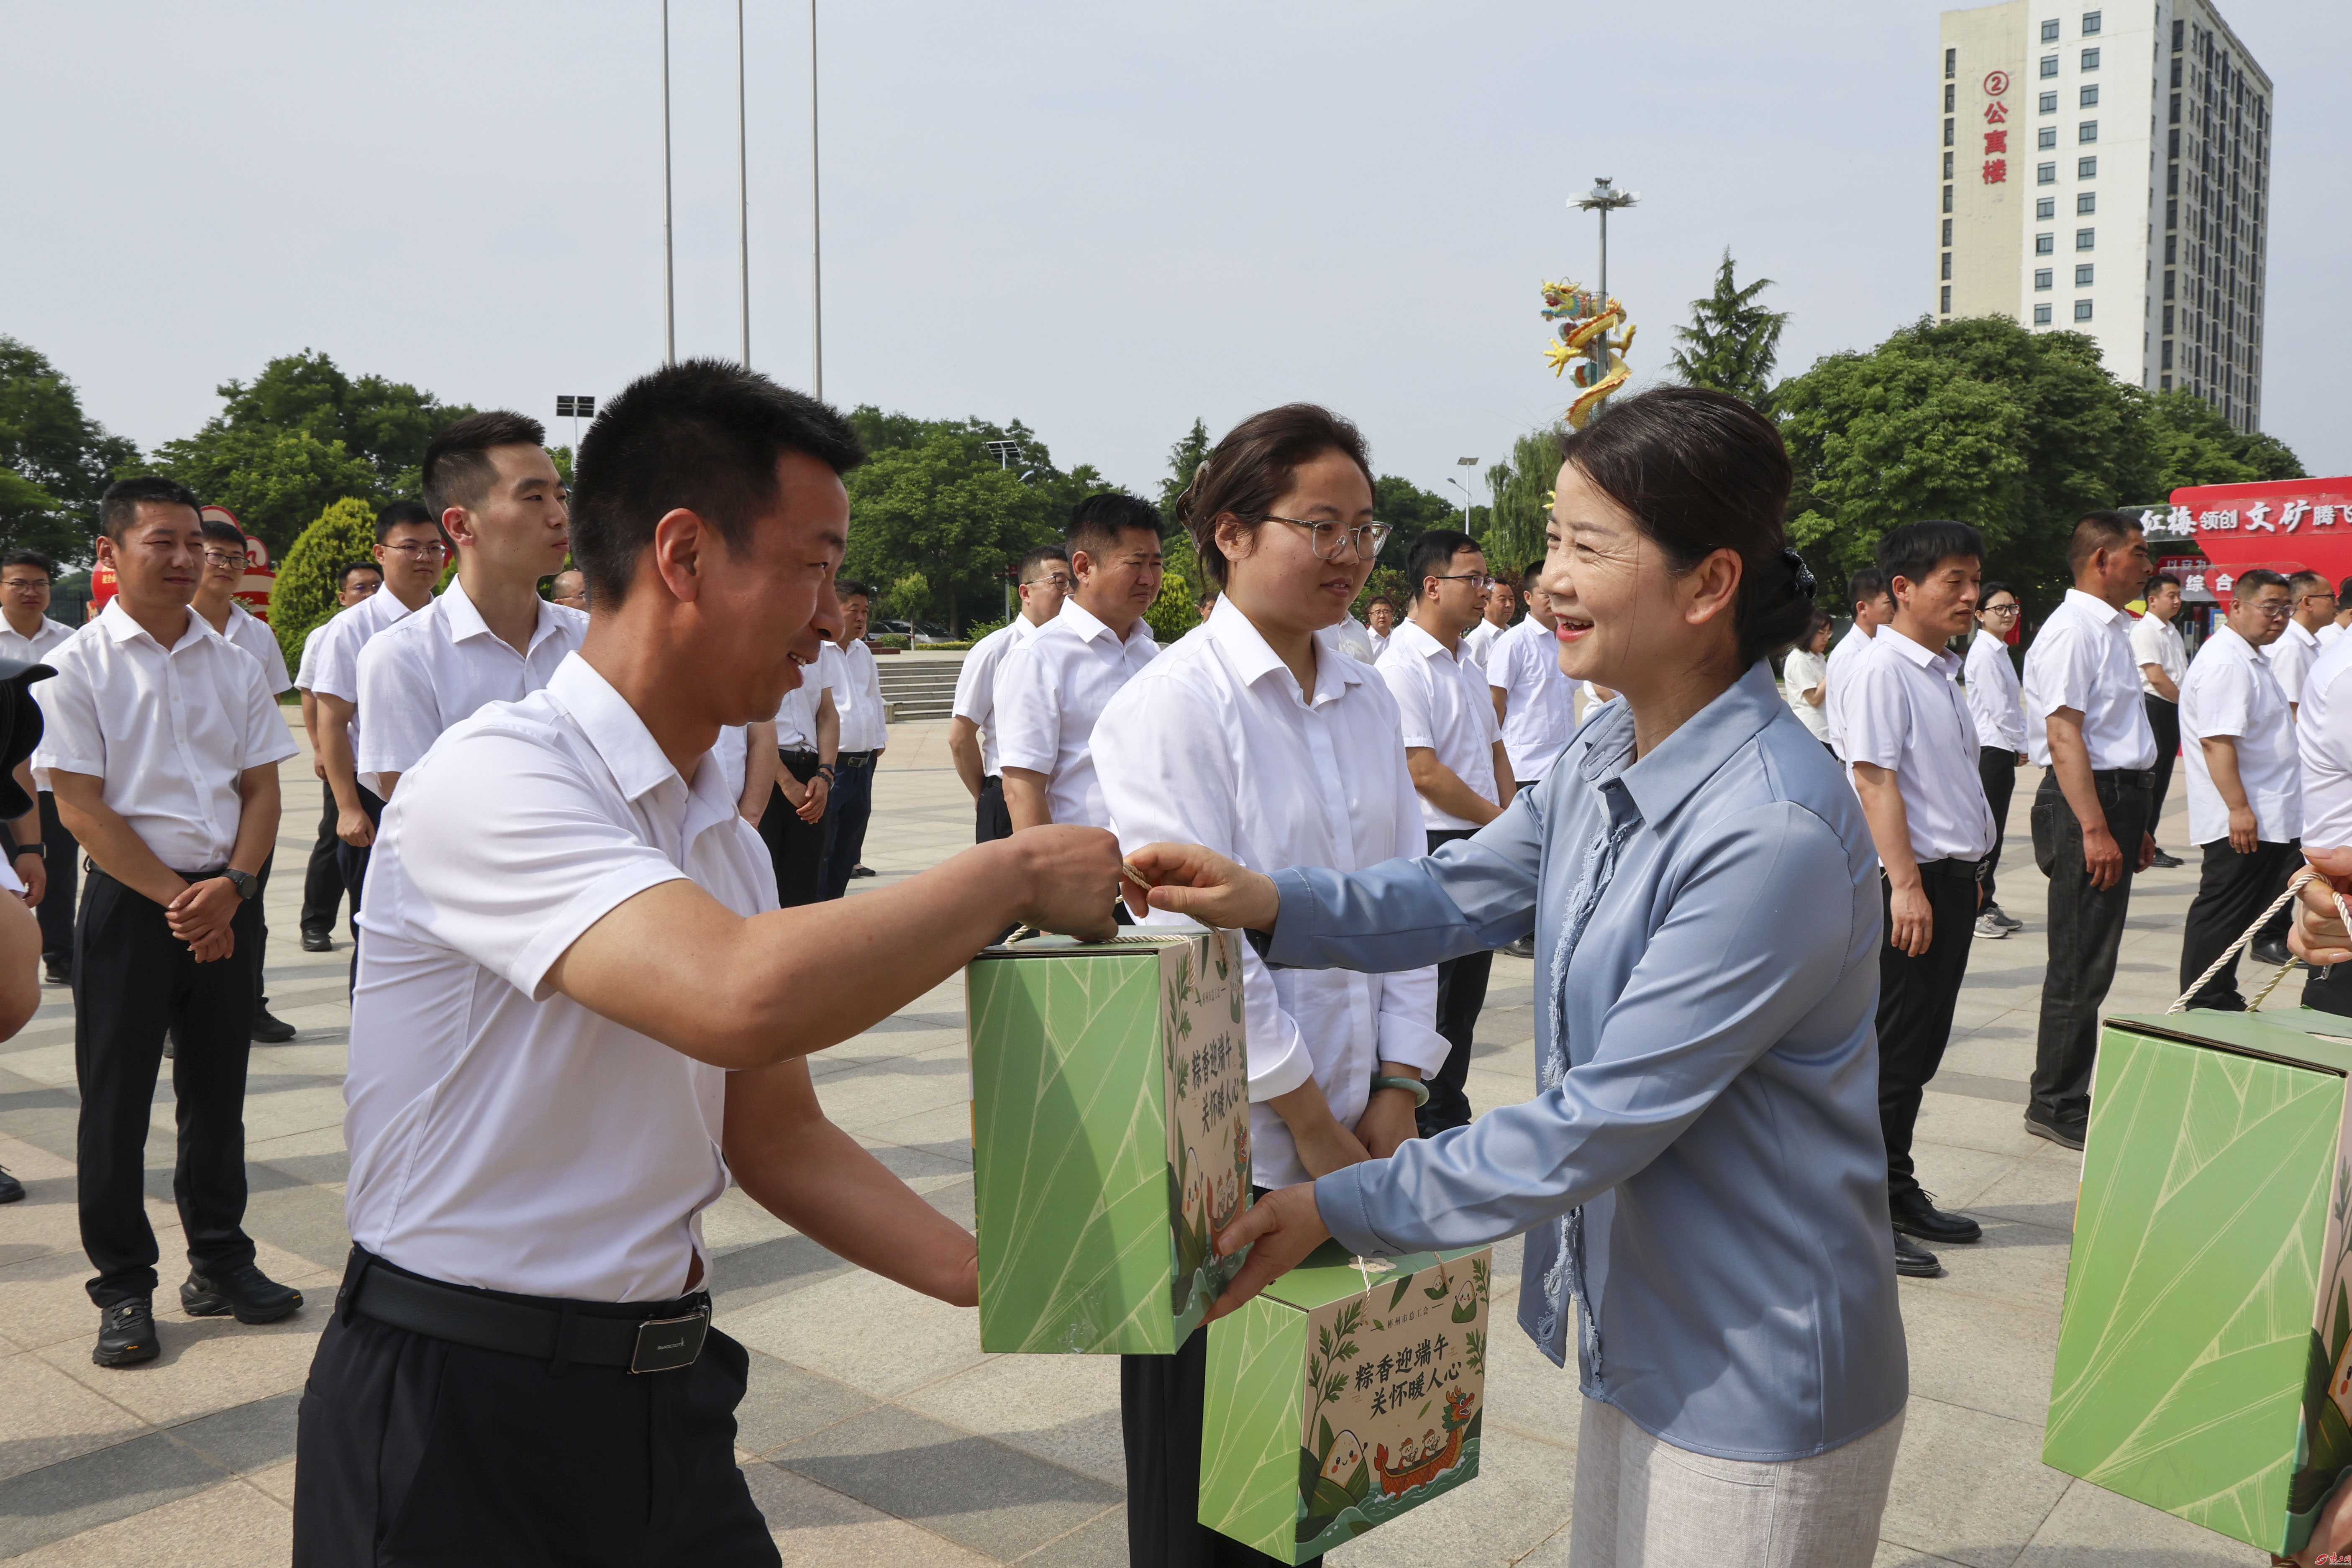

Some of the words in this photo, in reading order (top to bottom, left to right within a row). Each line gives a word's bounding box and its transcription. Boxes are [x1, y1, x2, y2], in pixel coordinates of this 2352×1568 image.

[1192, 1030, 1232, 1091] 粽香迎端午
[1202, 1078, 1239, 1138] 关怀暖人心
[1387, 1306, 1429, 1329] 彬州市总工会
[1354, 1333, 1449, 1392] 粽香迎端午
[1369, 1361, 1462, 1420] 关怀暖人心
